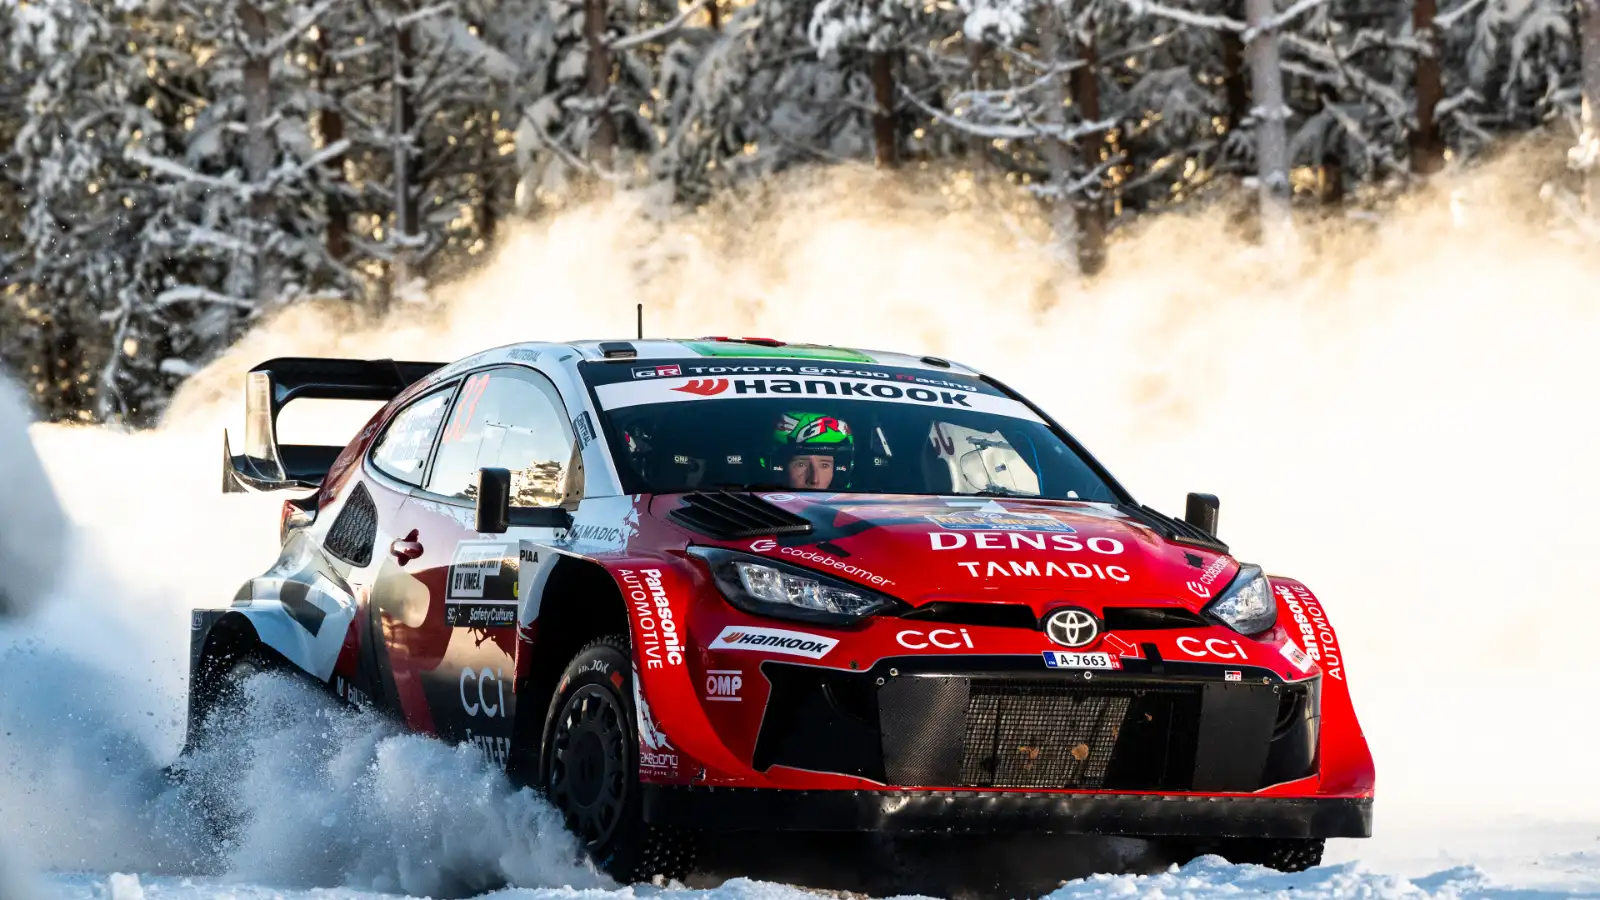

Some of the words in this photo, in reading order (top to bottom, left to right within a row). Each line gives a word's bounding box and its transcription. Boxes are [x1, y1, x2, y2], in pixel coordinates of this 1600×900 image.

[635, 368, 680, 378] GR
[688, 366, 793, 375] TOYOTA
[798, 366, 890, 379] GAZOO
[927, 531, 1125, 555] DENSO
[519, 549, 539, 564] PIAA
[780, 546, 892, 587] codebeamer
[957, 560, 1131, 582] TAMADIC
[618, 568, 664, 670] AUTOMOTIVE
[639, 568, 686, 666] Panasonic
[1275, 584, 1321, 662] anasonic
[895, 628, 975, 650] CCi
[1289, 584, 1343, 681] AUTOMOTIVE
[1060, 653, 1107, 667] A-7663
[1175, 635, 1249, 661] CCi
[459, 666, 506, 718] CCi
[706, 675, 743, 696] OMP
